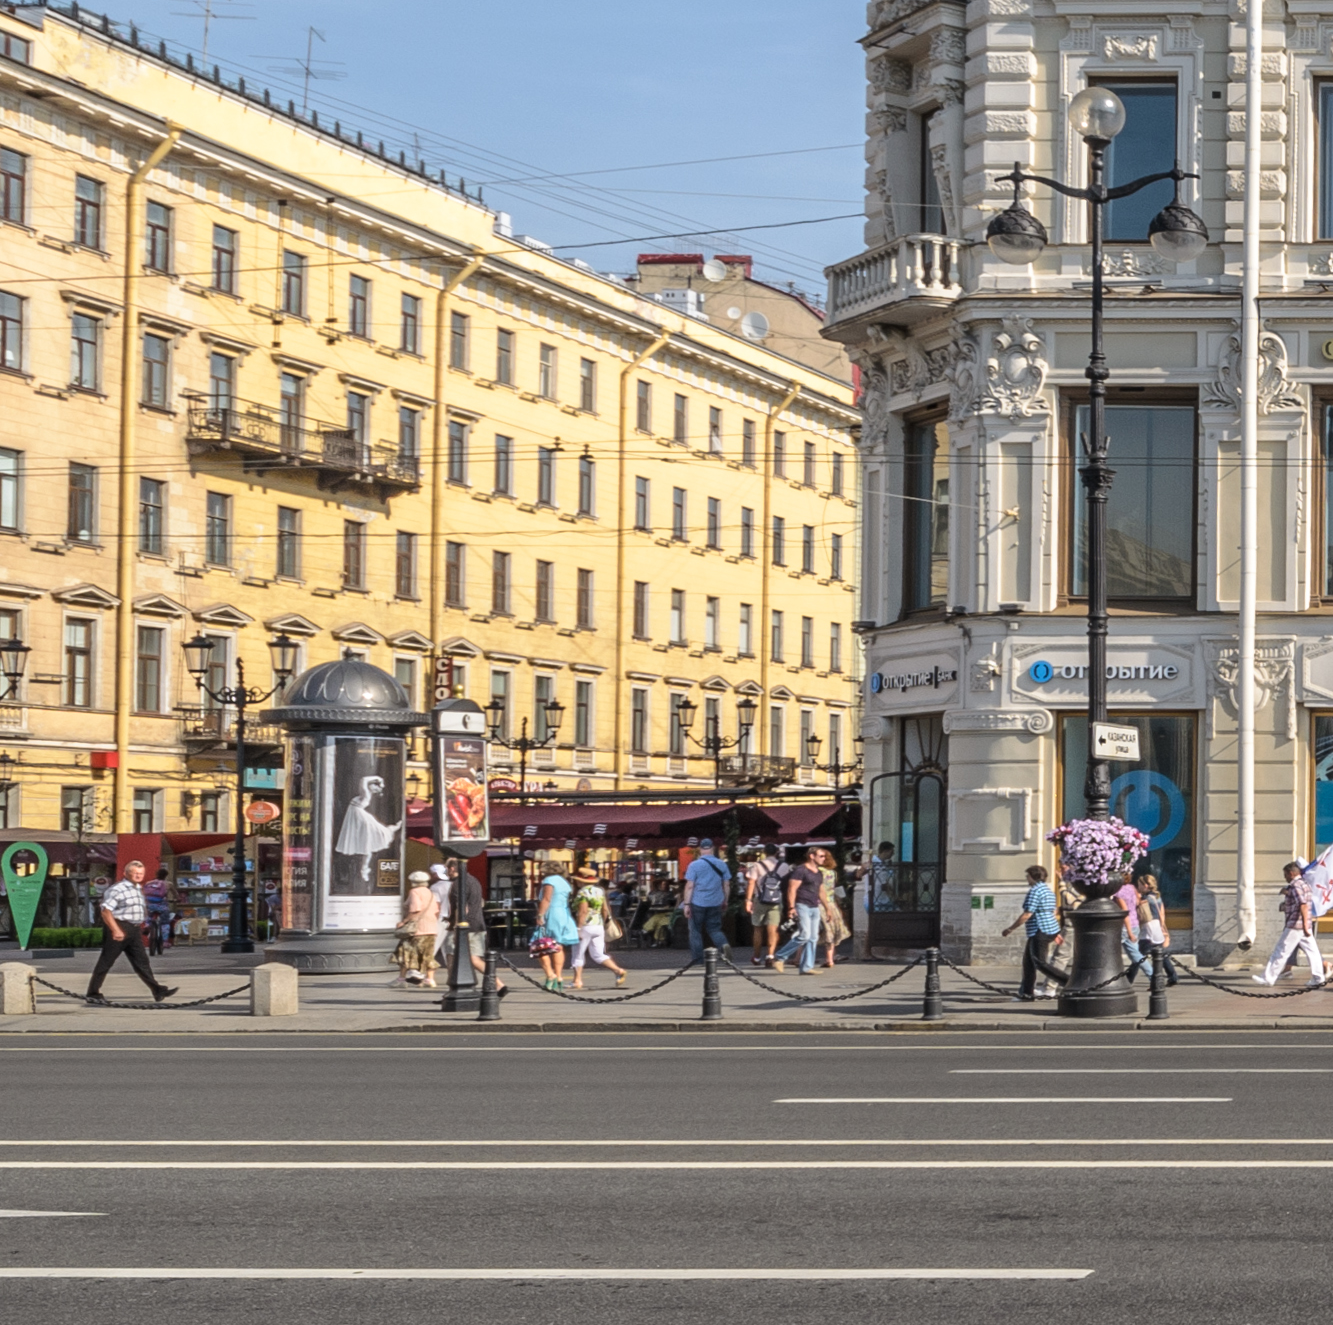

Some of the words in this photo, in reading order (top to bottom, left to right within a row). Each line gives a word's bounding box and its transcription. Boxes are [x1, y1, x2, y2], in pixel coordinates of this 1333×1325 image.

[1060, 664, 1178, 679] отрытие
[882, 671, 932, 692] открытие
[1108, 732, 1136, 743] КАЗАНСКАЯ
[1115, 746, 1129, 754] улица
